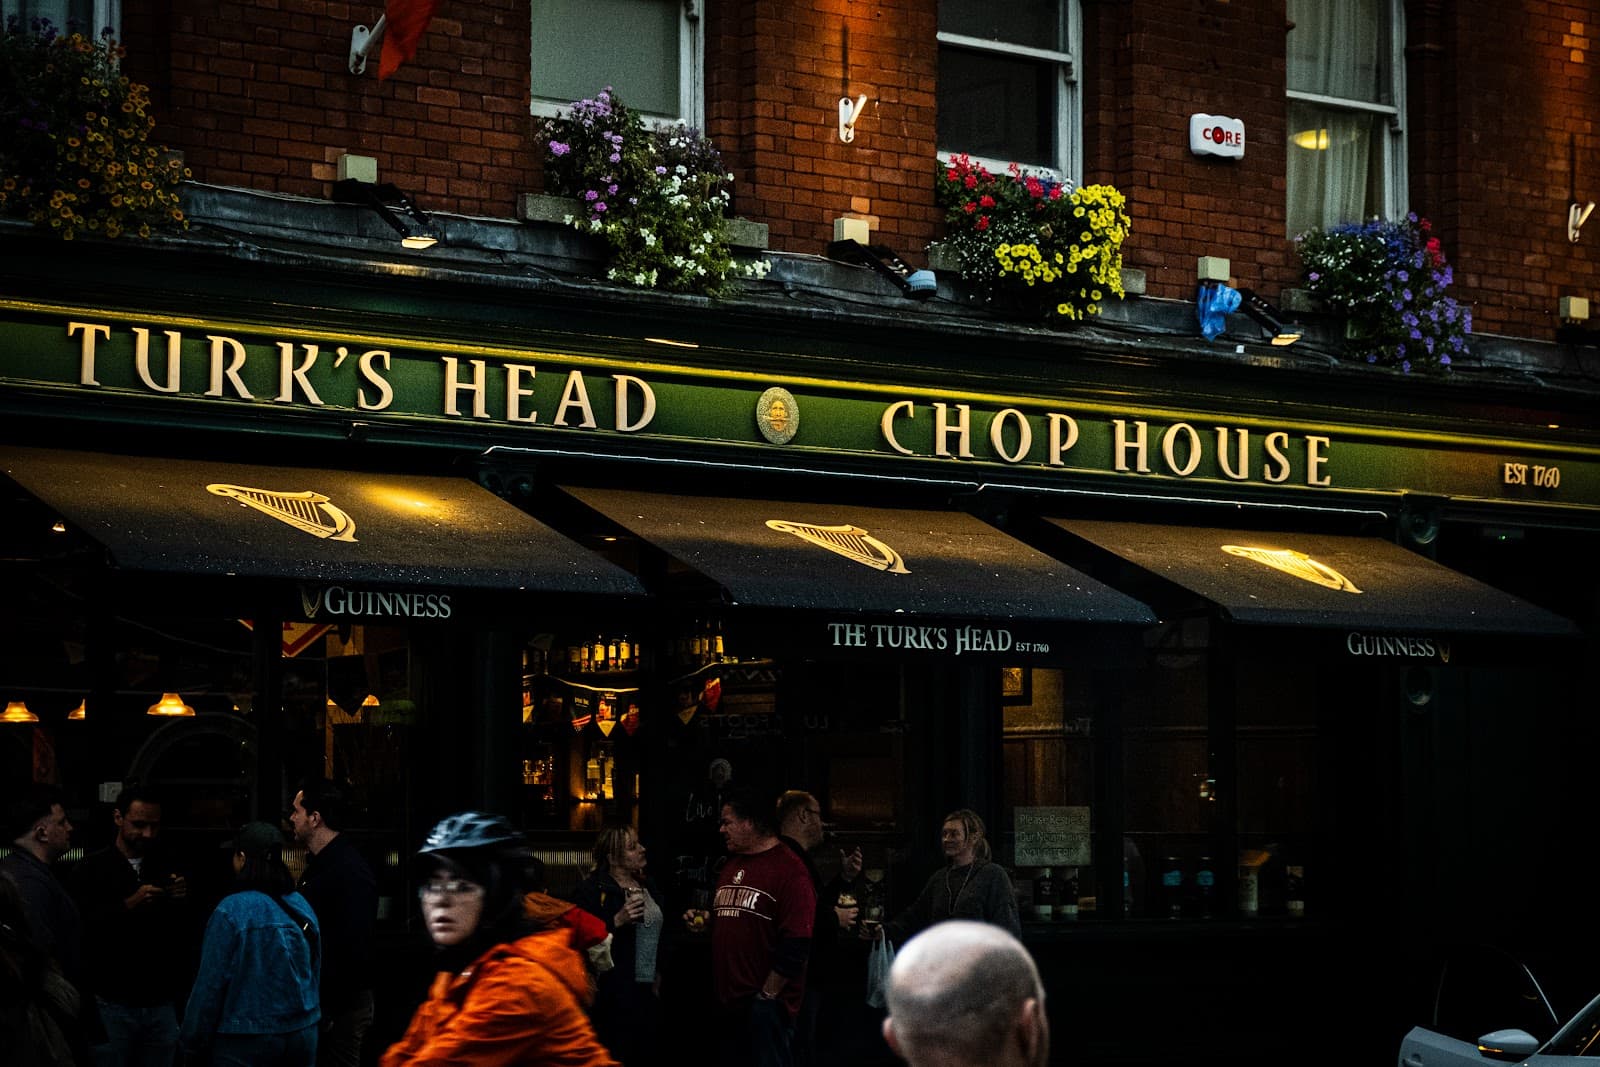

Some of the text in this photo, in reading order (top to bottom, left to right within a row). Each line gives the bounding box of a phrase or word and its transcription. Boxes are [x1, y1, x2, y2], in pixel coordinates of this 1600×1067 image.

[1203, 127, 1242, 145] CORE
[68, 322, 1332, 487] TURK'S HEAD CHOP HOUSE
[1504, 463, 1560, 488] EST 1760
[324, 586, 451, 618] GUINNESS
[828, 623, 1049, 656] THE TURK'S HEAD EST 1760
[1347, 632, 1435, 657] GUINNESS
